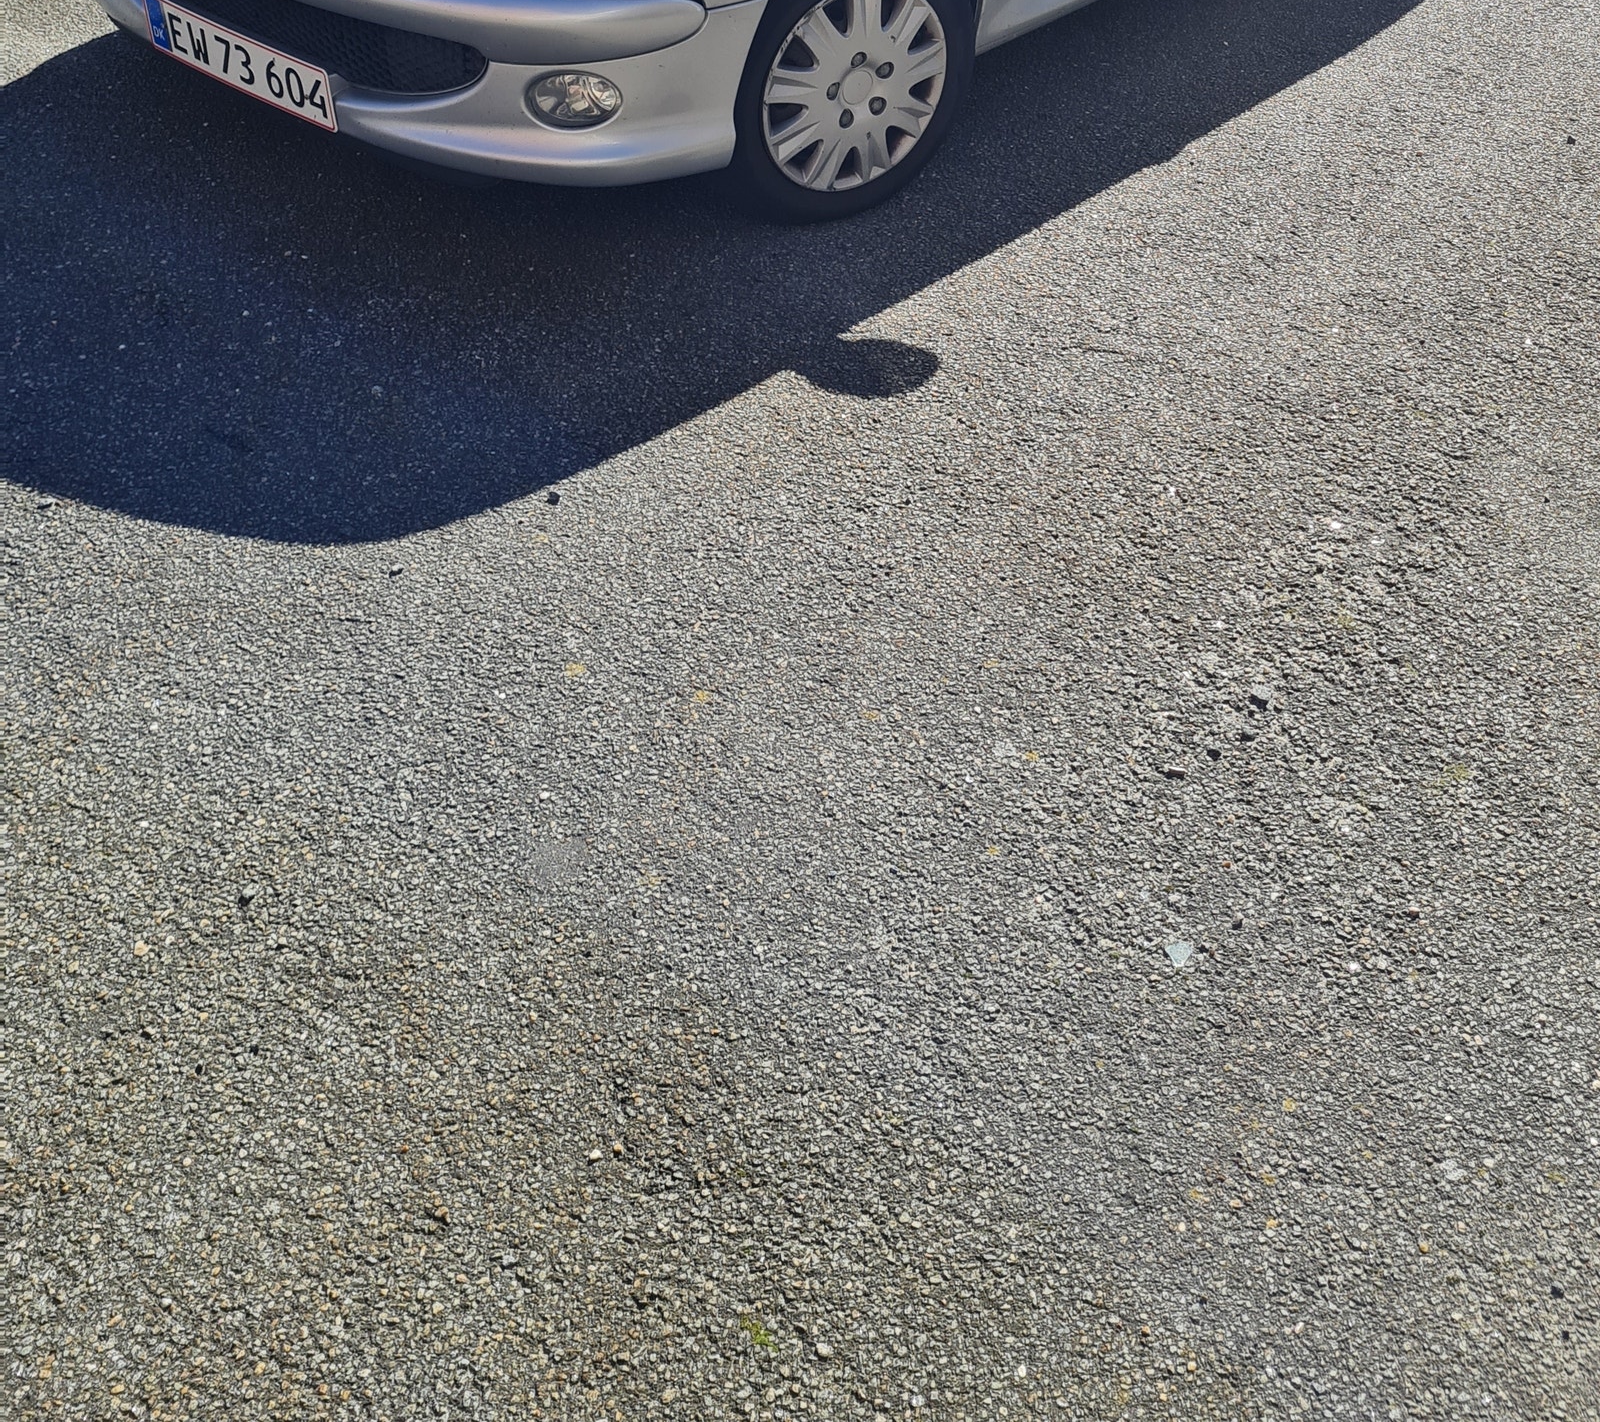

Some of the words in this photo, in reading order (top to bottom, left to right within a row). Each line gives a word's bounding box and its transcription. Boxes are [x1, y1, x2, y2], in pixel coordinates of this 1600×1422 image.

[153, 26, 165, 41] DK
[167, 12, 210, 66] EW
[214, 35, 255, 85] 73
[265, 60, 328, 119] 604
